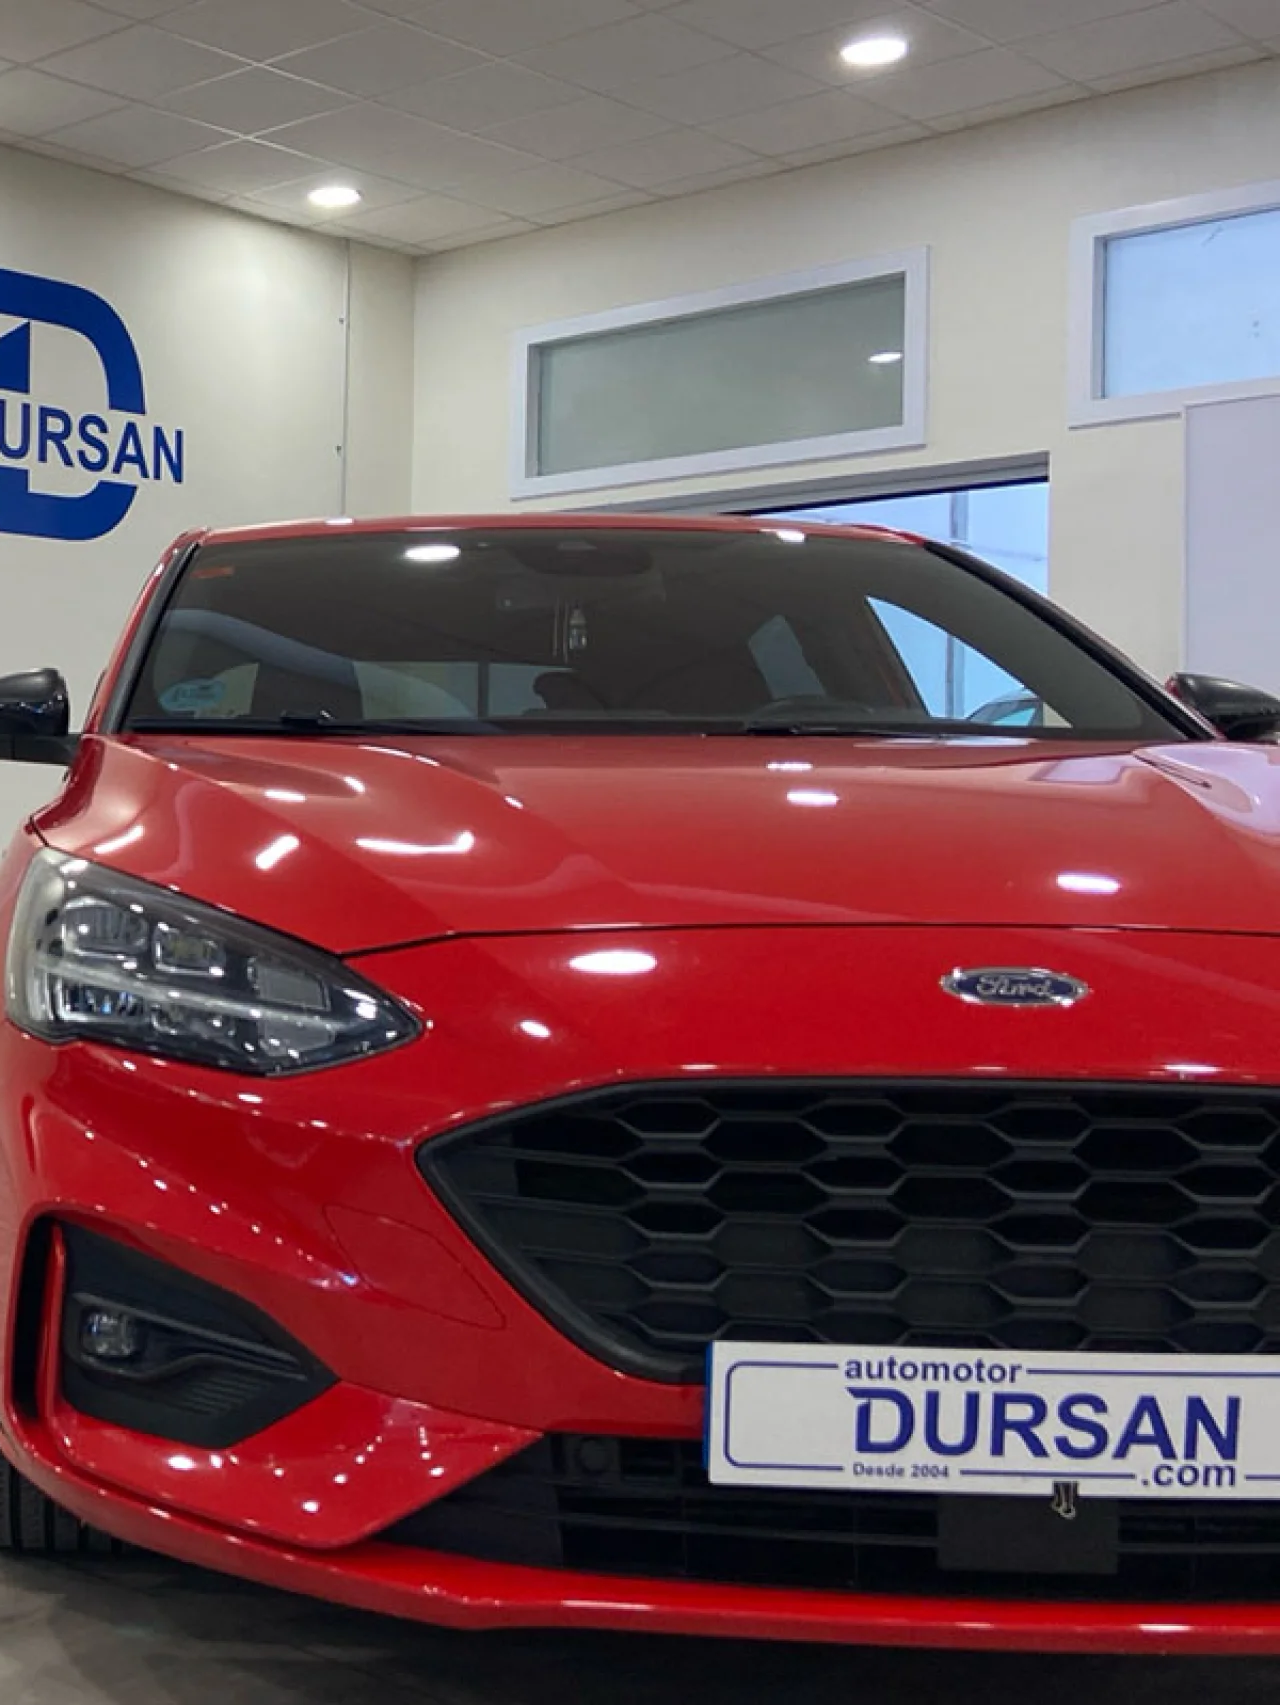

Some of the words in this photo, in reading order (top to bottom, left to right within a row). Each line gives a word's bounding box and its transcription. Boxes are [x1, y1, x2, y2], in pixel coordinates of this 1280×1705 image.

[976, 976, 1052, 997] Ford
[845, 1356, 1022, 1384] automotor
[846, 1387, 1241, 1460] DURSAN
[852, 1462, 905, 1478] Desde
[910, 1464, 949, 1479] 2004
[1142, 1463, 1237, 1487] .com
